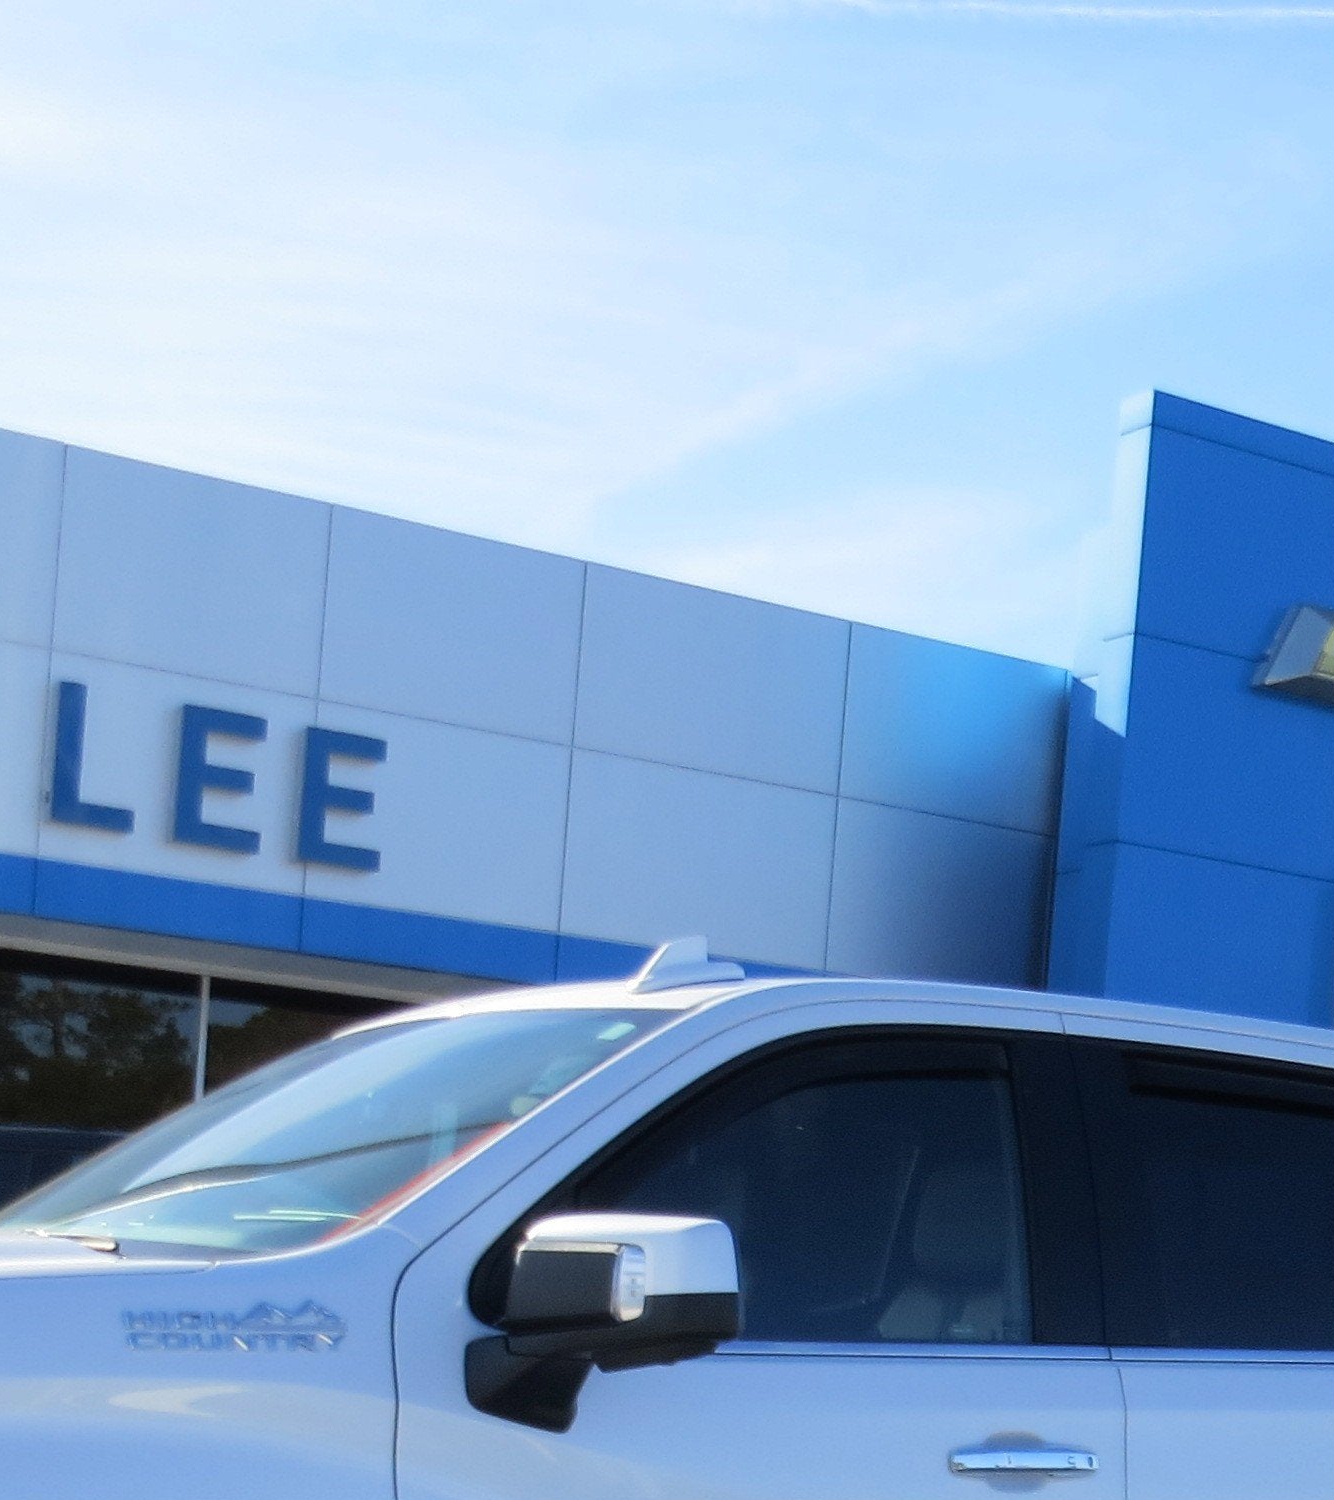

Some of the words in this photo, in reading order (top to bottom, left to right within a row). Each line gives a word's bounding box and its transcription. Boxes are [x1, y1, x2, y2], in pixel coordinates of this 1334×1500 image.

[51, 681, 388, 873] LEE
[122, 1311, 238, 1331] HIGH
[125, 1332, 345, 1351] COUNTRY
